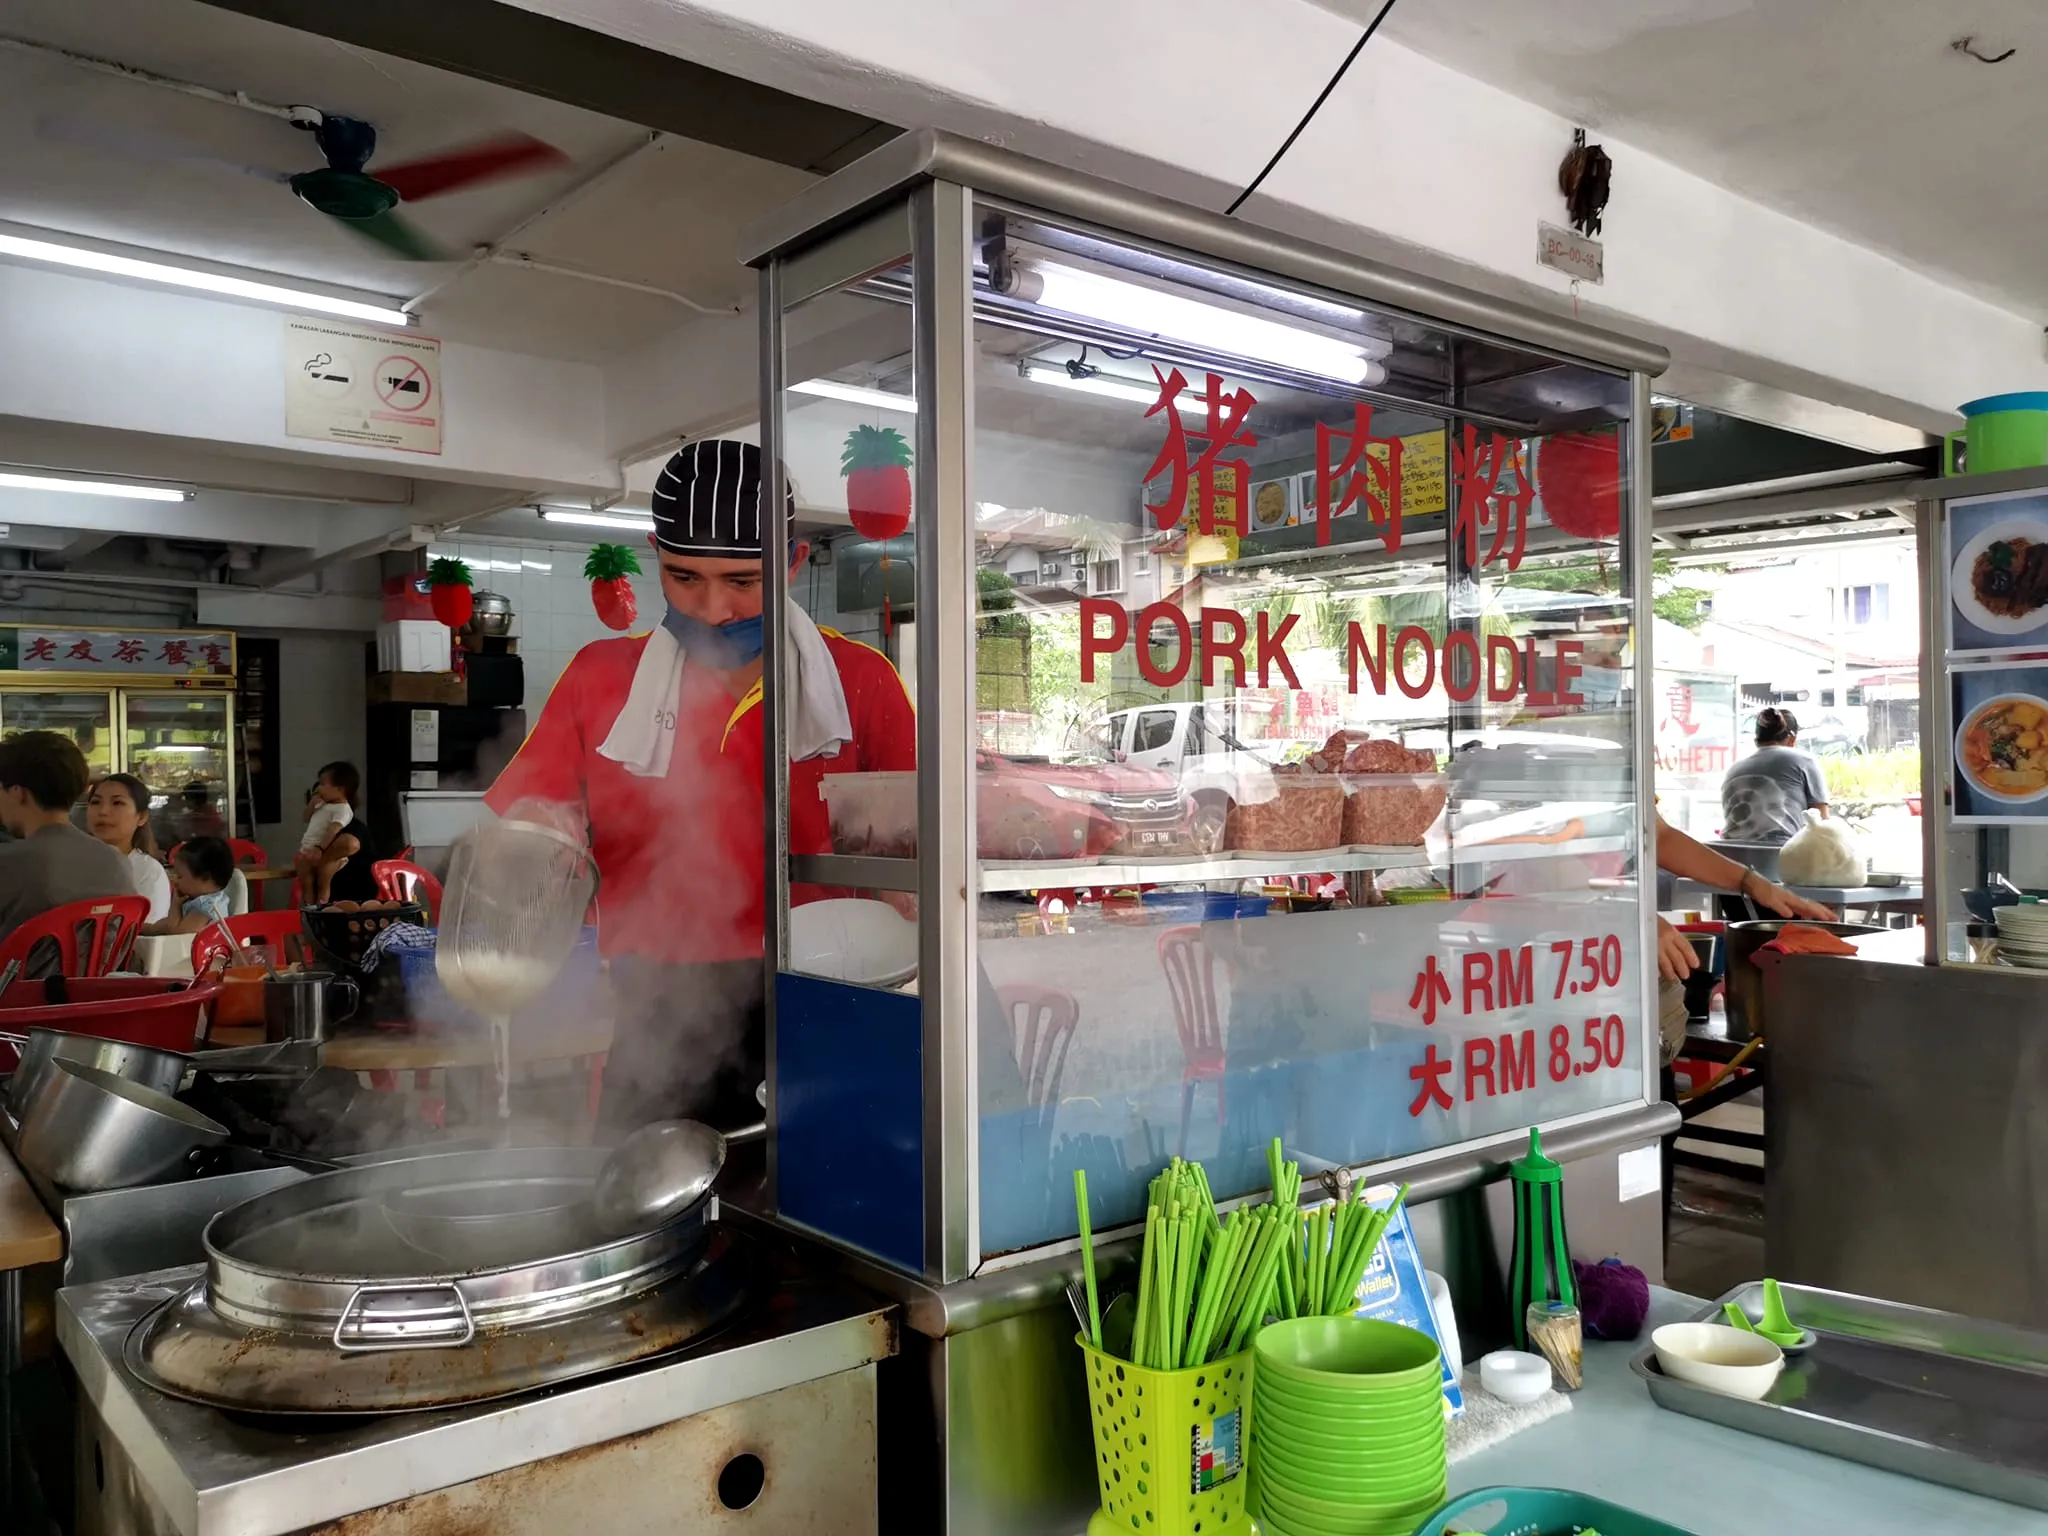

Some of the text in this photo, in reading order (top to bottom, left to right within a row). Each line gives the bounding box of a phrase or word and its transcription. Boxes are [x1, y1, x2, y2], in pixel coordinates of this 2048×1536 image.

[1142, 363, 1536, 571] 猪肉粉
[1080, 599, 1584, 706] PORK NOODLE
[1409, 934, 1622, 1025] 小 RM 7.50
[1409, 1014, 1625, 1117] 大 RM 8.50
